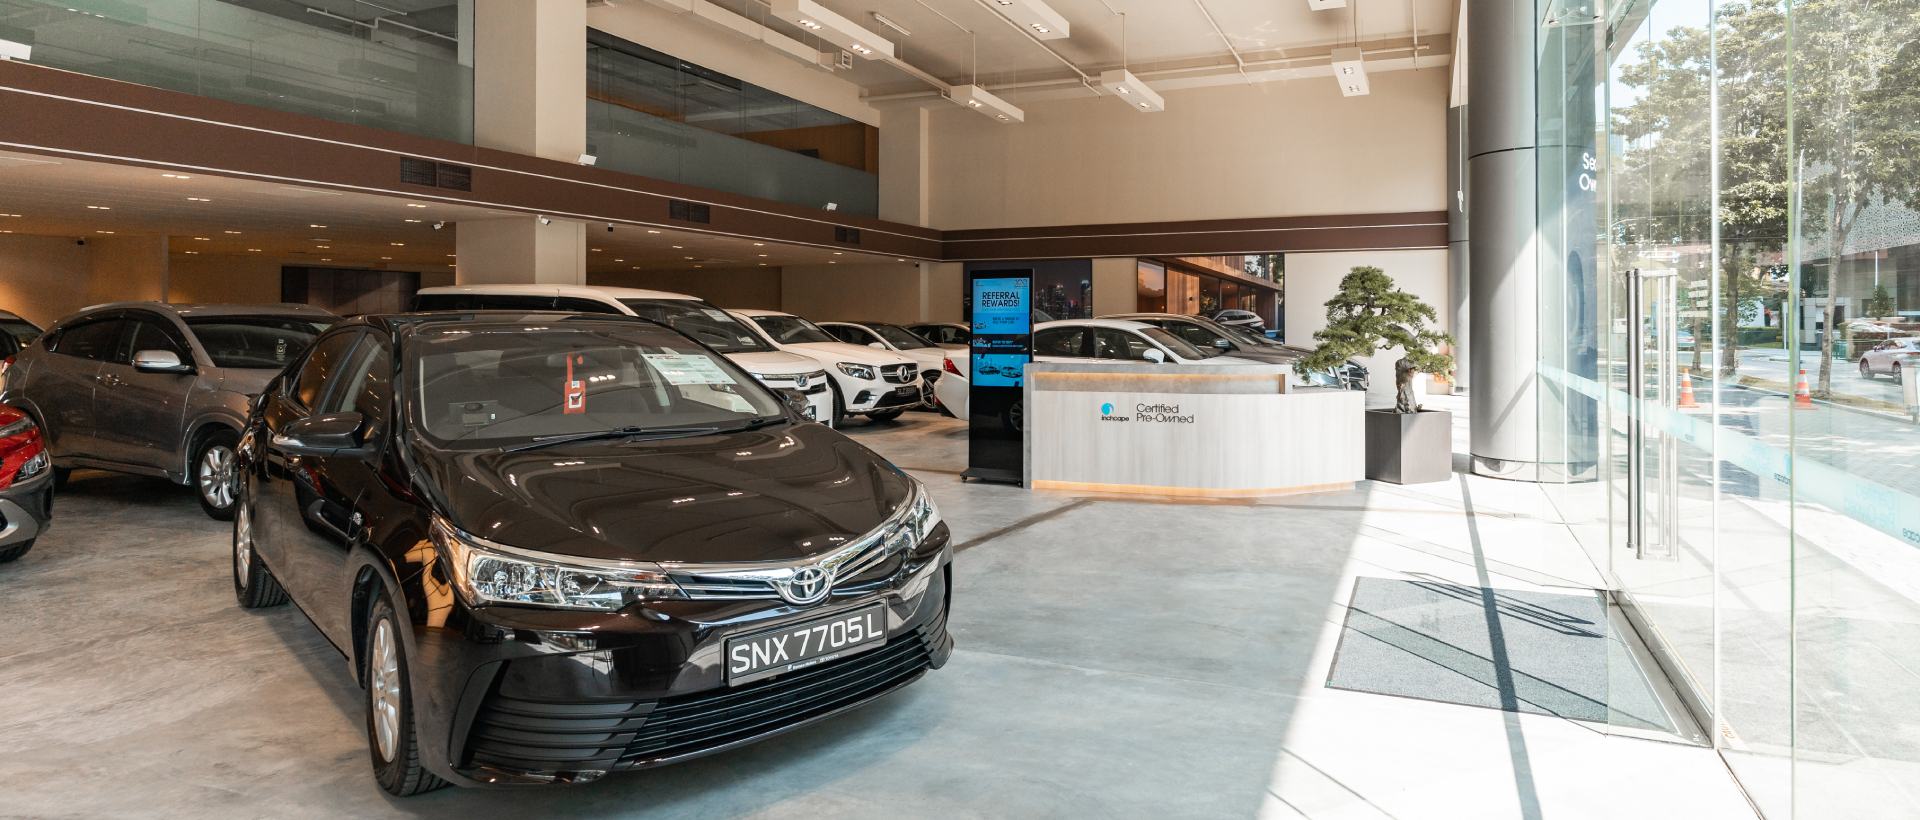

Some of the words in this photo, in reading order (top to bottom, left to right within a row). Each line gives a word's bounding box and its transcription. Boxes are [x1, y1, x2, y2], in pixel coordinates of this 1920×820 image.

[982, 291, 1020, 299] REFERRAL
[1136, 403, 1180, 413] Certified
[1136, 413, 1195, 424] Pre-Owned
[731, 634, 789, 674] SNX
